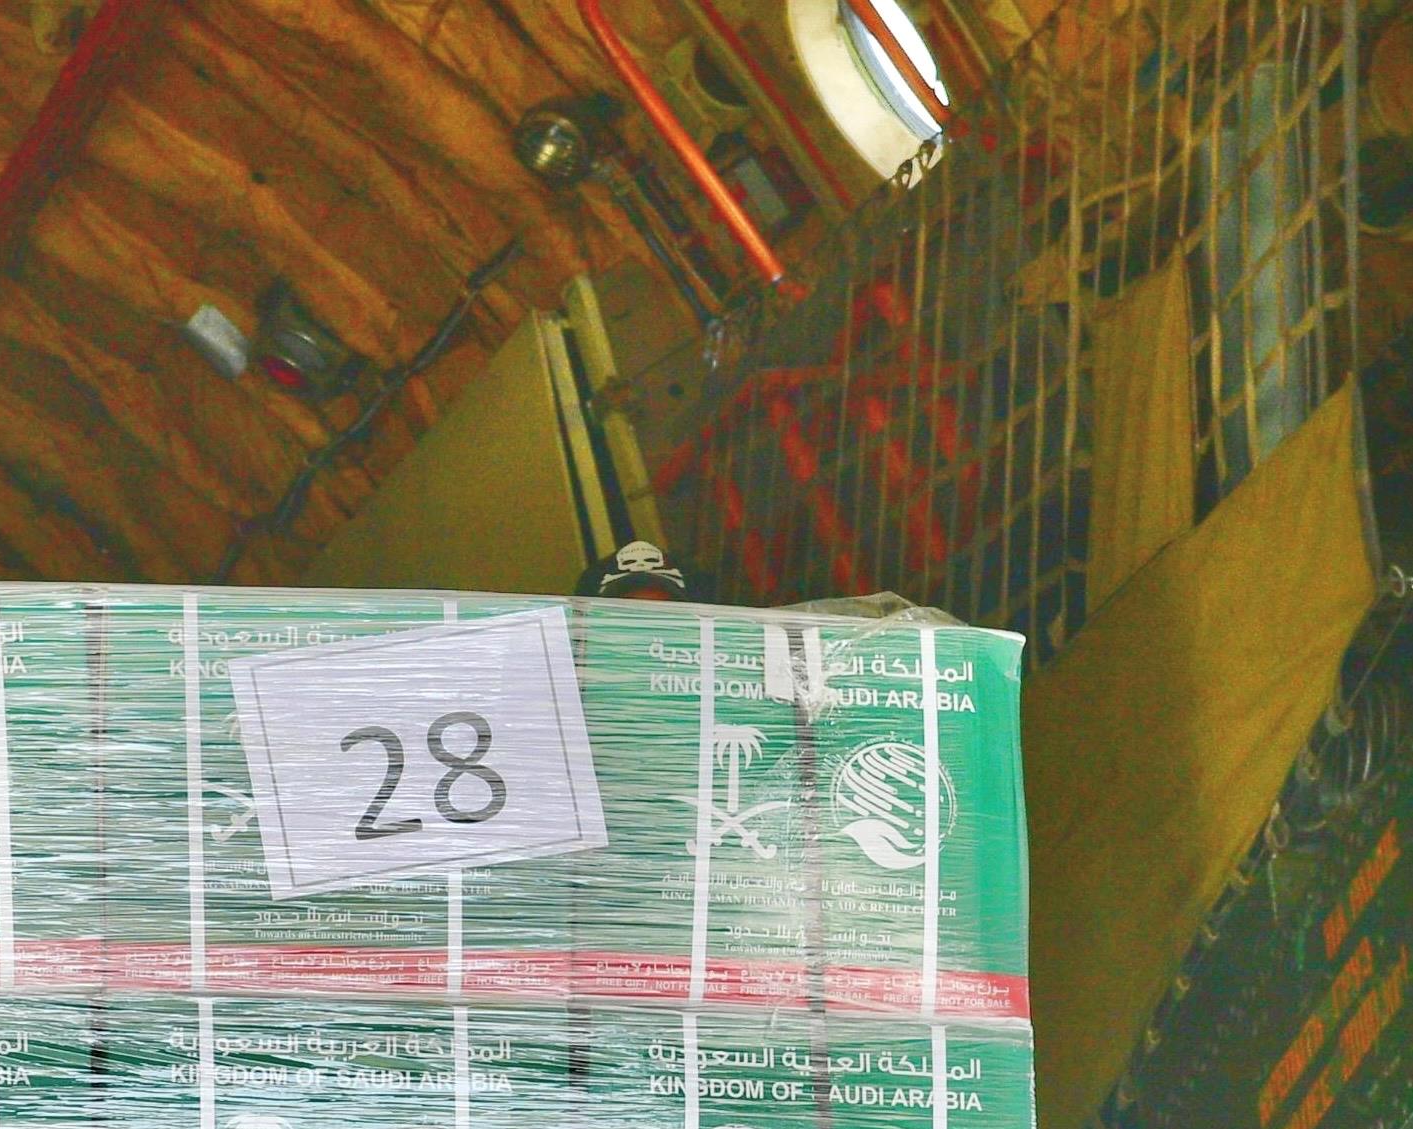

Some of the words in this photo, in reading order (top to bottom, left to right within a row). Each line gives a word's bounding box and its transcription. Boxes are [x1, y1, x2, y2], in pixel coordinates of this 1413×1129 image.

[339, 710, 507, 841] 28
[170, 1064, 288, 1087] KIGDOM
[296, 1067, 328, 1089] OF
[421, 1071, 513, 1094] ARBIA
[772, 1080, 804, 1102] OF
[826, 1084, 885, 1107] AUDI
